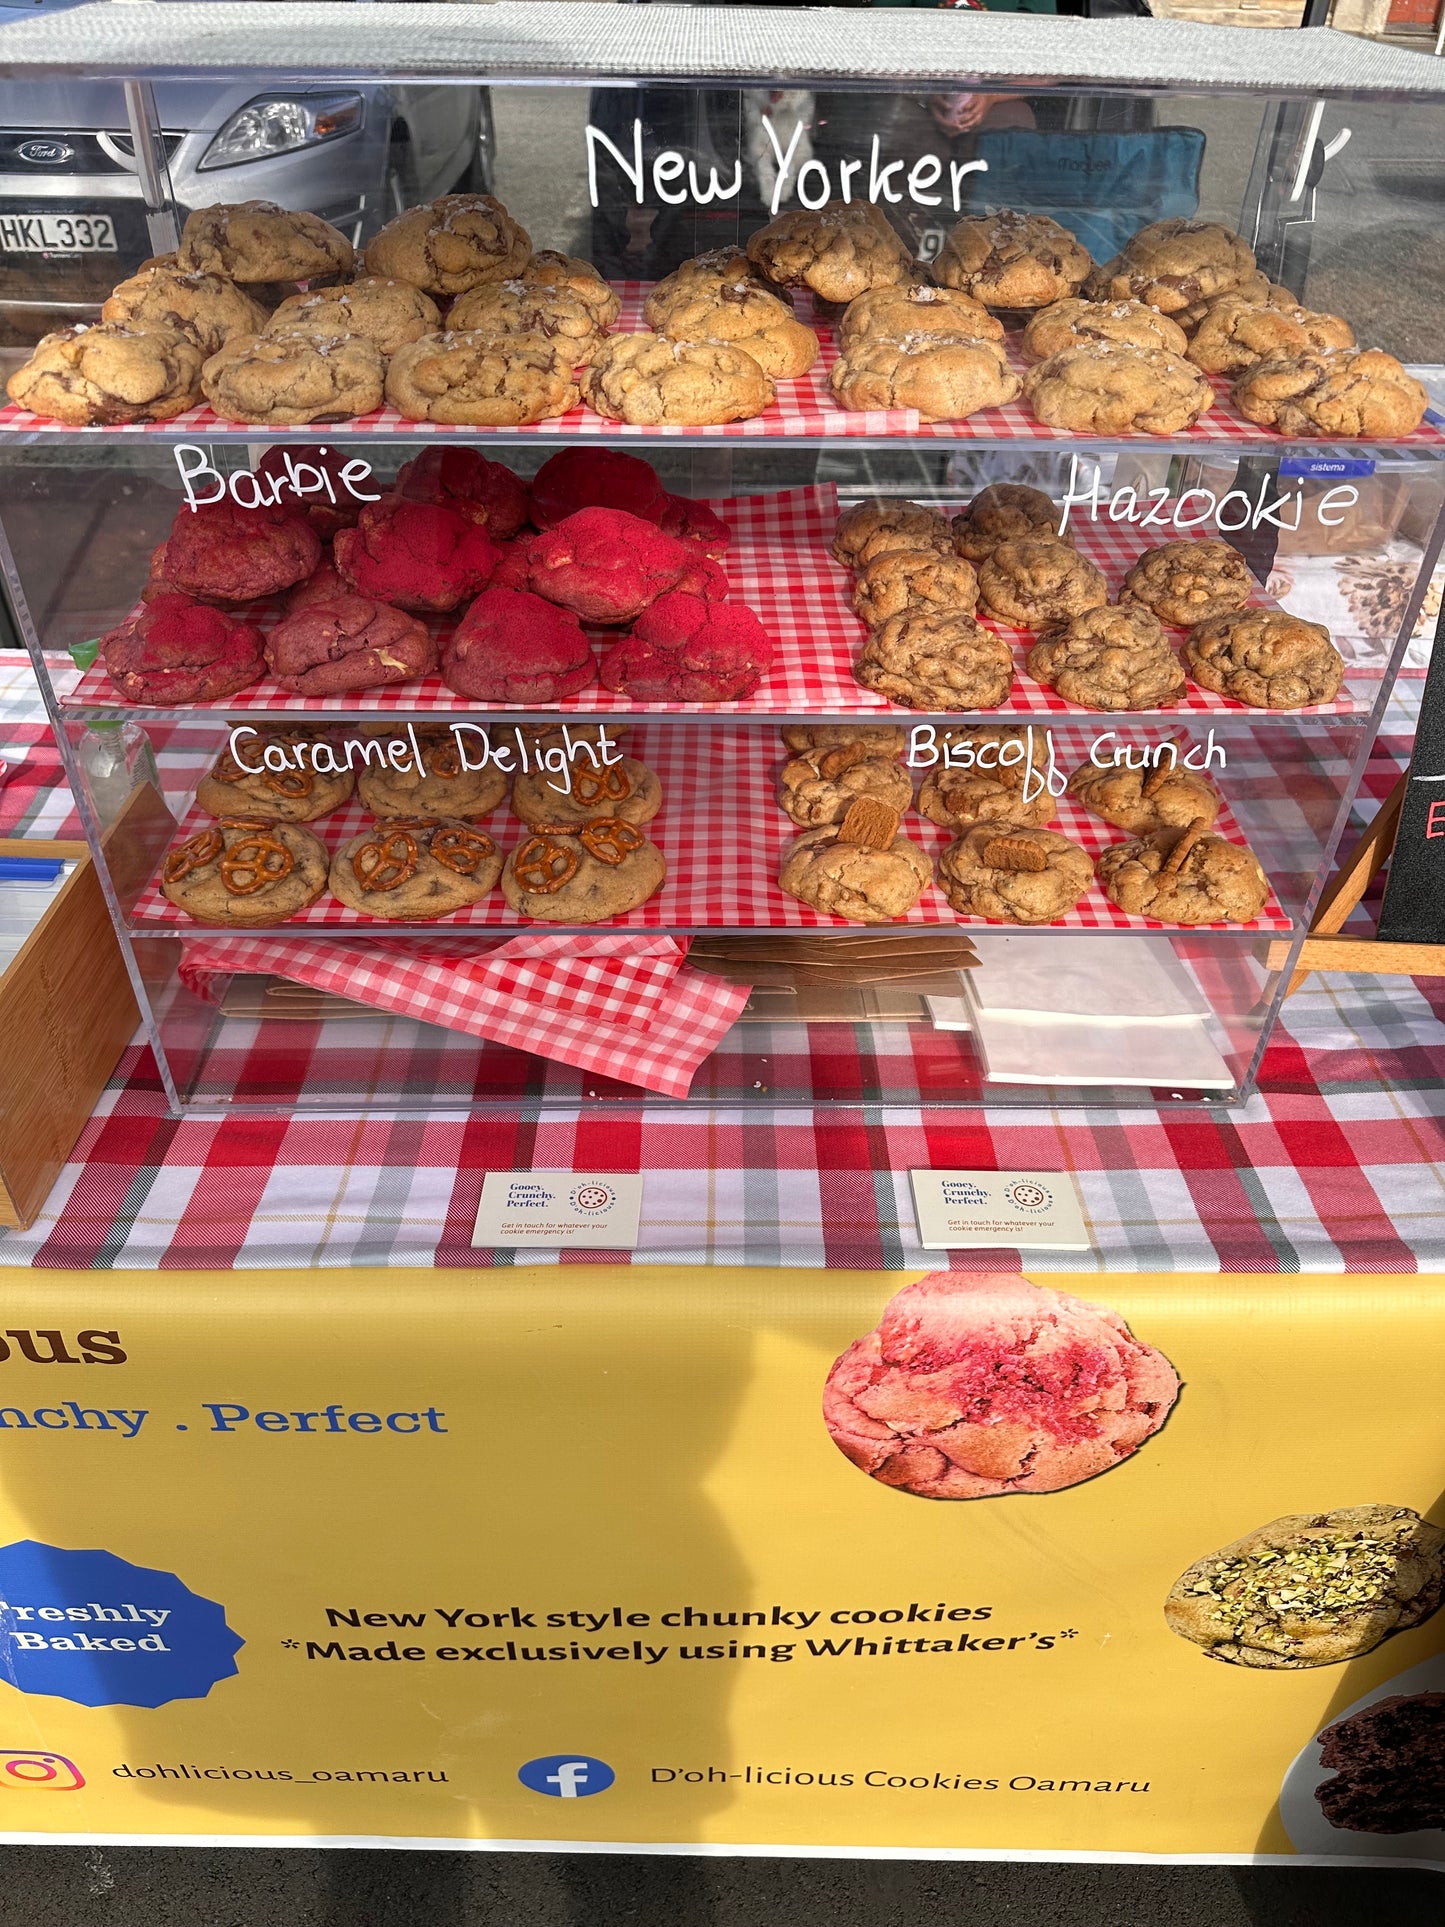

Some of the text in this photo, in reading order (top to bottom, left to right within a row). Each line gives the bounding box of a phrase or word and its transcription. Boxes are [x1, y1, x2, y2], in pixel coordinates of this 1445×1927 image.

[30, 145, 56, 157] Ford
[586, 115, 989, 215] New Yorker
[1, 219, 114, 248] HKL332
[173, 444, 381, 513] Barbie
[1309, 462, 1346, 472] sistema
[1057, 453, 1360, 537] Hazookie
[230, 723, 426, 779] Caramel
[450, 723, 624, 794] Delight
[906, 725, 1227, 804] Biscoff Crunch
[508, 1191, 556, 1200] Crunchy.
[510, 1183, 544, 1192] Gooey.
[941, 1180, 976, 1189] Gooey.
[943, 1188, 991, 1198] Crunchy.
[506, 1199, 549, 1208] Perfect.
[944, 1197, 987, 1205] Perfect.
[201, 1403, 449, 1434] Perfect
[325, 1603, 993, 1632] New York style chunky cookies
[9, 1632, 171, 1651] Baked
[436, 1640, 669, 1665] exclusively
[679, 1639, 796, 1662] using
[112, 1763, 450, 1784] dohlicious_oamaru
[651, 1766, 855, 1787] D'oh-licious
[864, 1770, 999, 1790] Cookies
[1009, 1776, 1150, 1793] Oamaru
